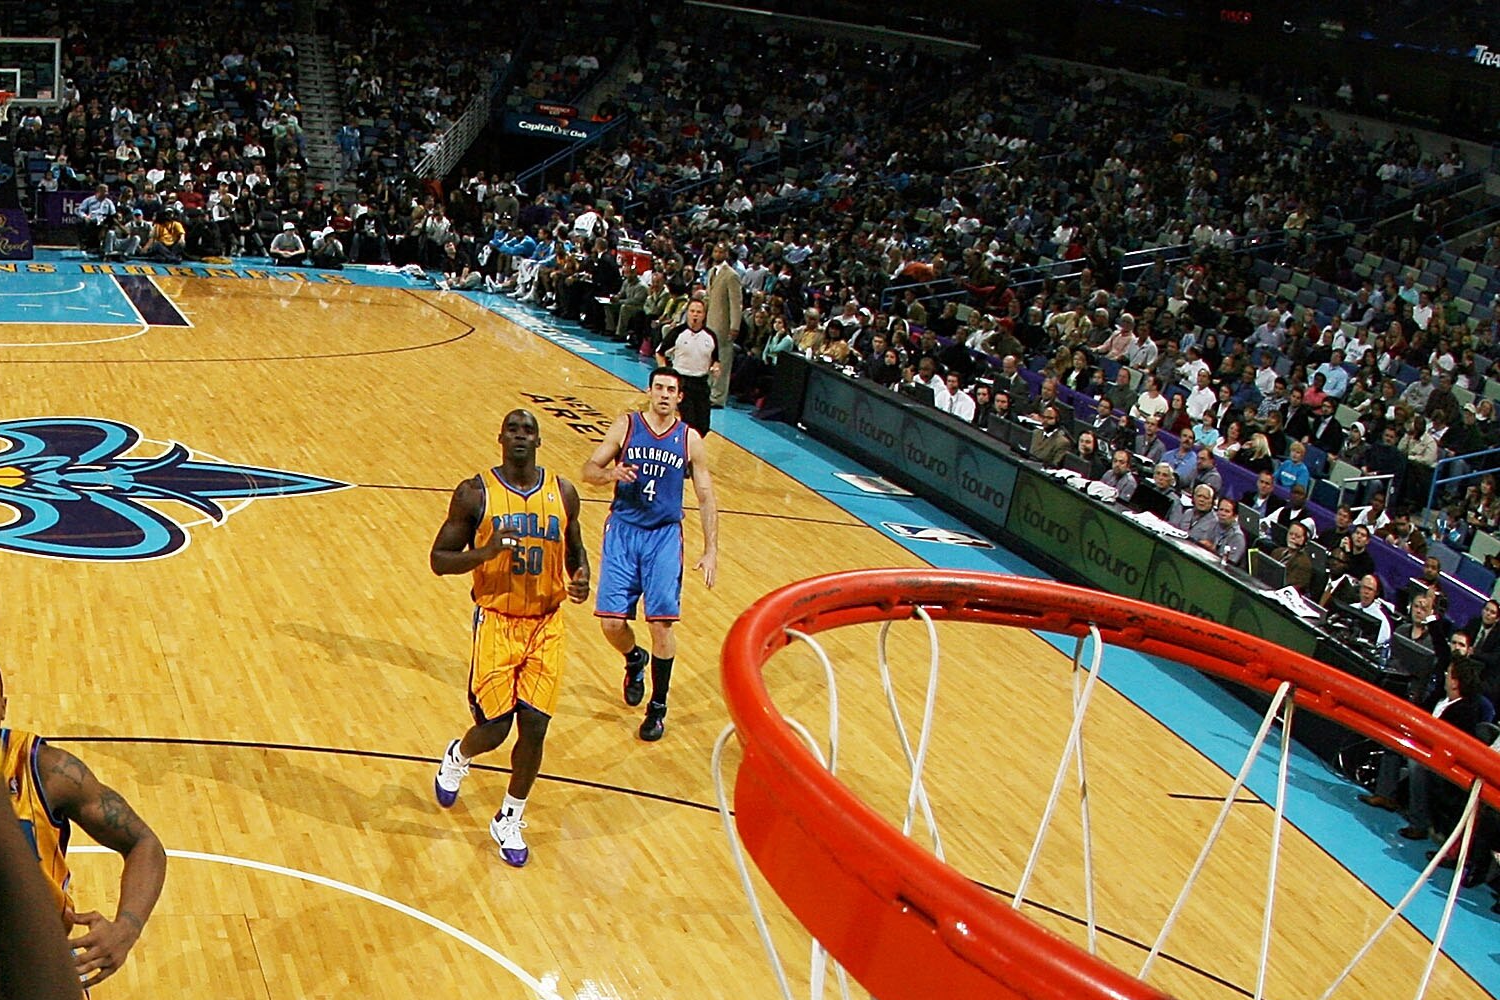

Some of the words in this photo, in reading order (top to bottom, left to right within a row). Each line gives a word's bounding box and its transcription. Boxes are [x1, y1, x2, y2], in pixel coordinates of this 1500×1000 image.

[80, 263, 356, 285] HORNETS
[813, 397, 849, 424] touro
[859, 417, 895, 448] touro
[627, 446, 684, 470] OKLAHOMA
[642, 462, 666, 478] CITY
[906, 443, 949, 477] touro
[642, 479, 657, 502] 4
[962, 470, 1005, 508] touro
[1022, 505, 1070, 544] touro
[512, 545, 544, 576] 50
[1087, 539, 1141, 586] touro
